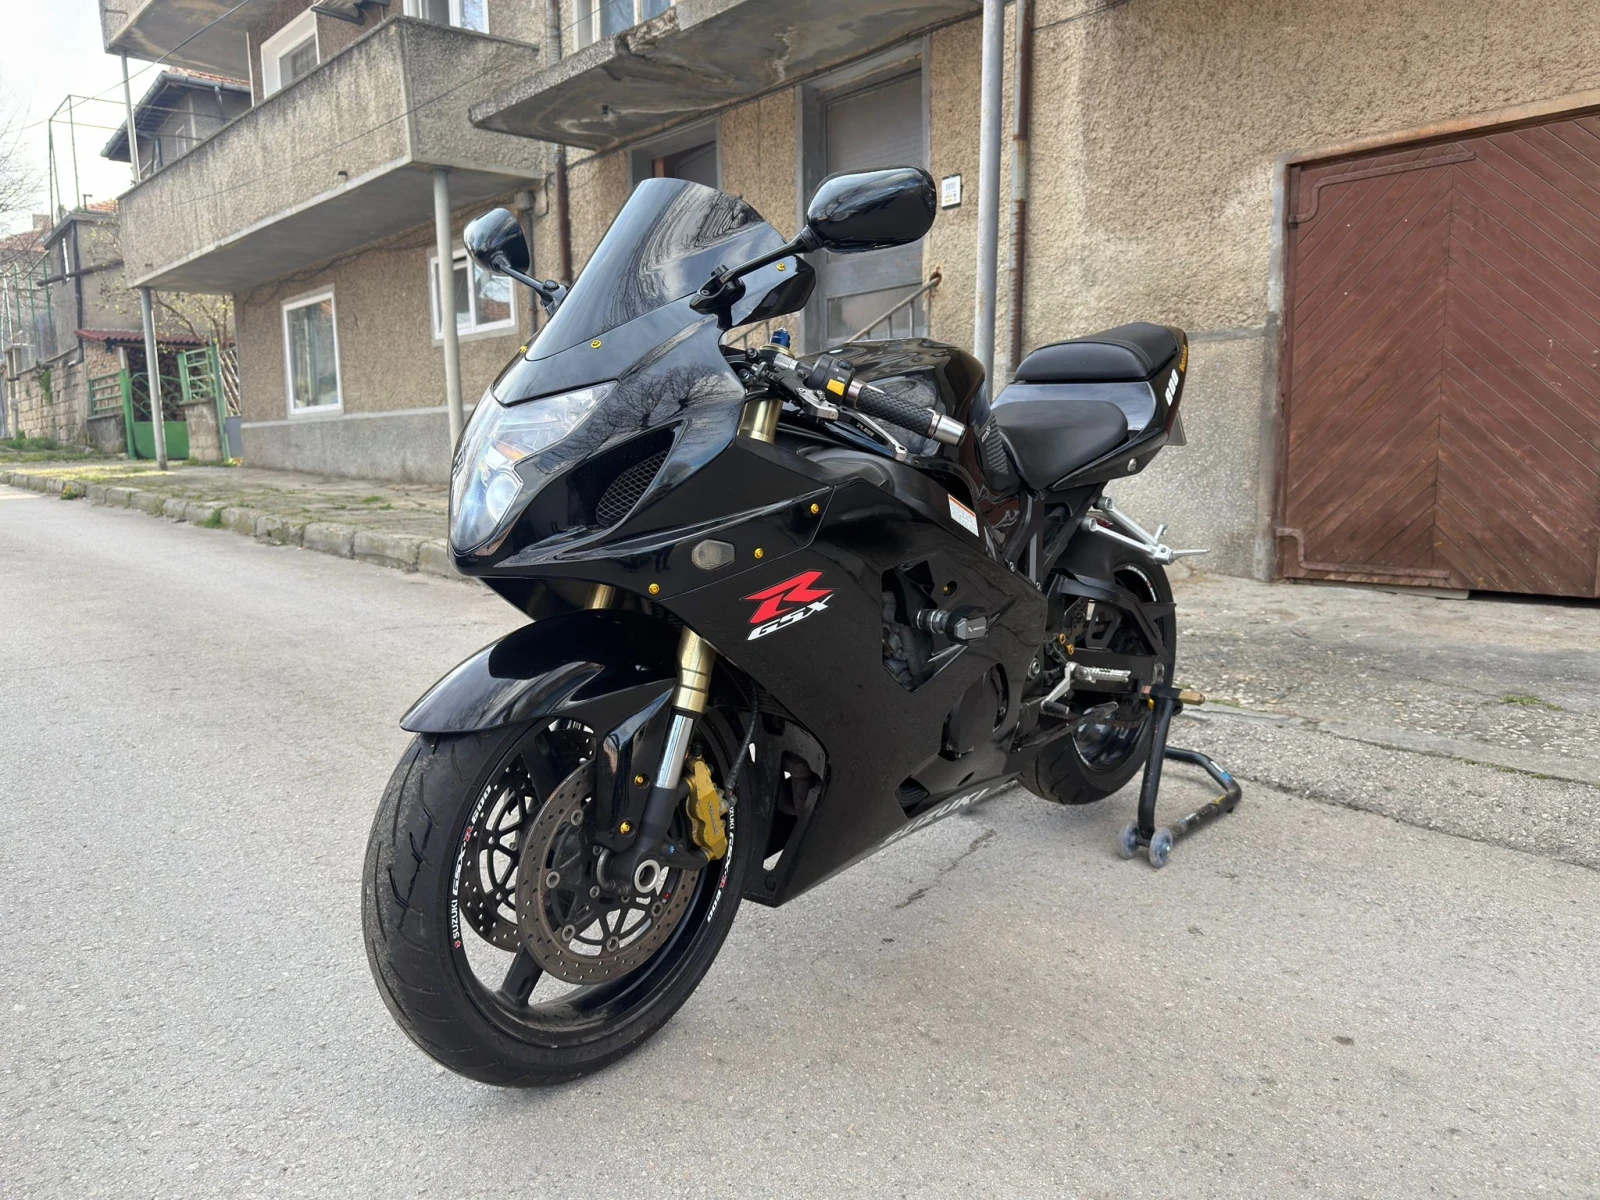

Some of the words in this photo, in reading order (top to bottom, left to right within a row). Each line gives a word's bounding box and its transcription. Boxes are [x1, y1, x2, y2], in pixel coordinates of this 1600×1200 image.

[1165, 369, 1179, 406] 600
[744, 569, 835, 625] R
[746, 594, 834, 641] GSX
[879, 787, 989, 848] SUZUKI
[451, 899, 460, 939] SUZUKI
